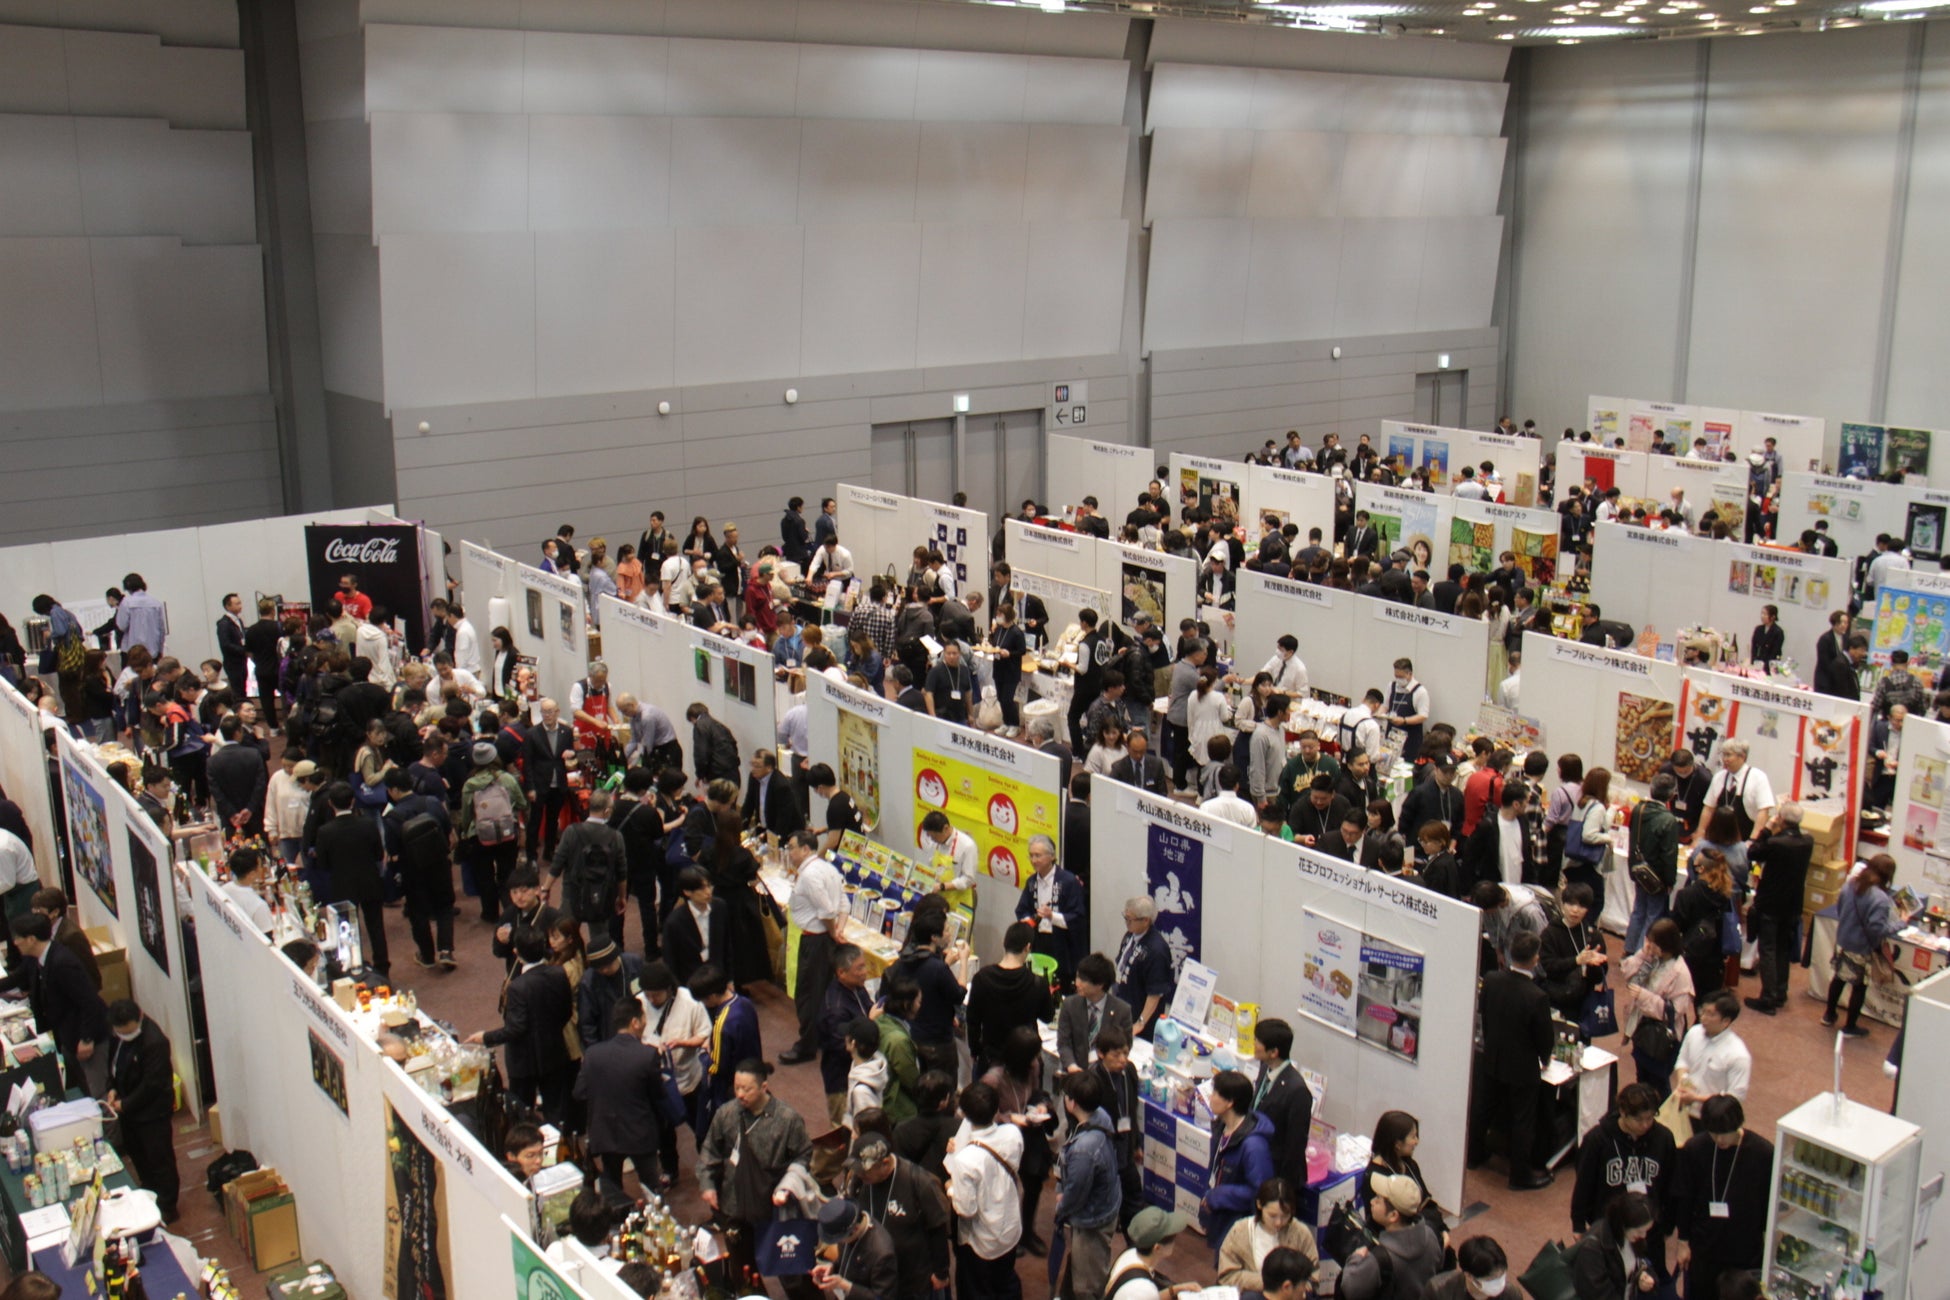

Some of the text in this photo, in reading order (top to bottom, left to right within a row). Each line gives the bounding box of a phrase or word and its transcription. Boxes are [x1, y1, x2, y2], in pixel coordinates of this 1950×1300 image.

[1485, 507, 1528, 520] 株式会社アスク
[325, 538, 401, 563] Coca-Cola
[1122, 551, 1164, 567] 株式会社ひろひろ
[1385, 607, 1449, 630] 株式会社八幡フーズ
[1555, 645, 1648, 675] テーブルマーク株式会社
[825, 684, 885, 718] 株式会社スリーアローズ
[1730, 684, 1813, 711] 甘強酒造株式会社
[951, 732, 1016, 764] 東洋水産株式会社
[1136, 798, 1213, 838] 永山酒造合名会社
[1158, 832, 1192, 852] 山口県
[1162, 846, 1186, 864] 地酒
[1298, 857, 1438, 920] 花王プロフェッショナル・サービス株式会社
[421, 1109, 453, 1158] 株式会社
[1606, 1155, 1660, 1188] GAP
